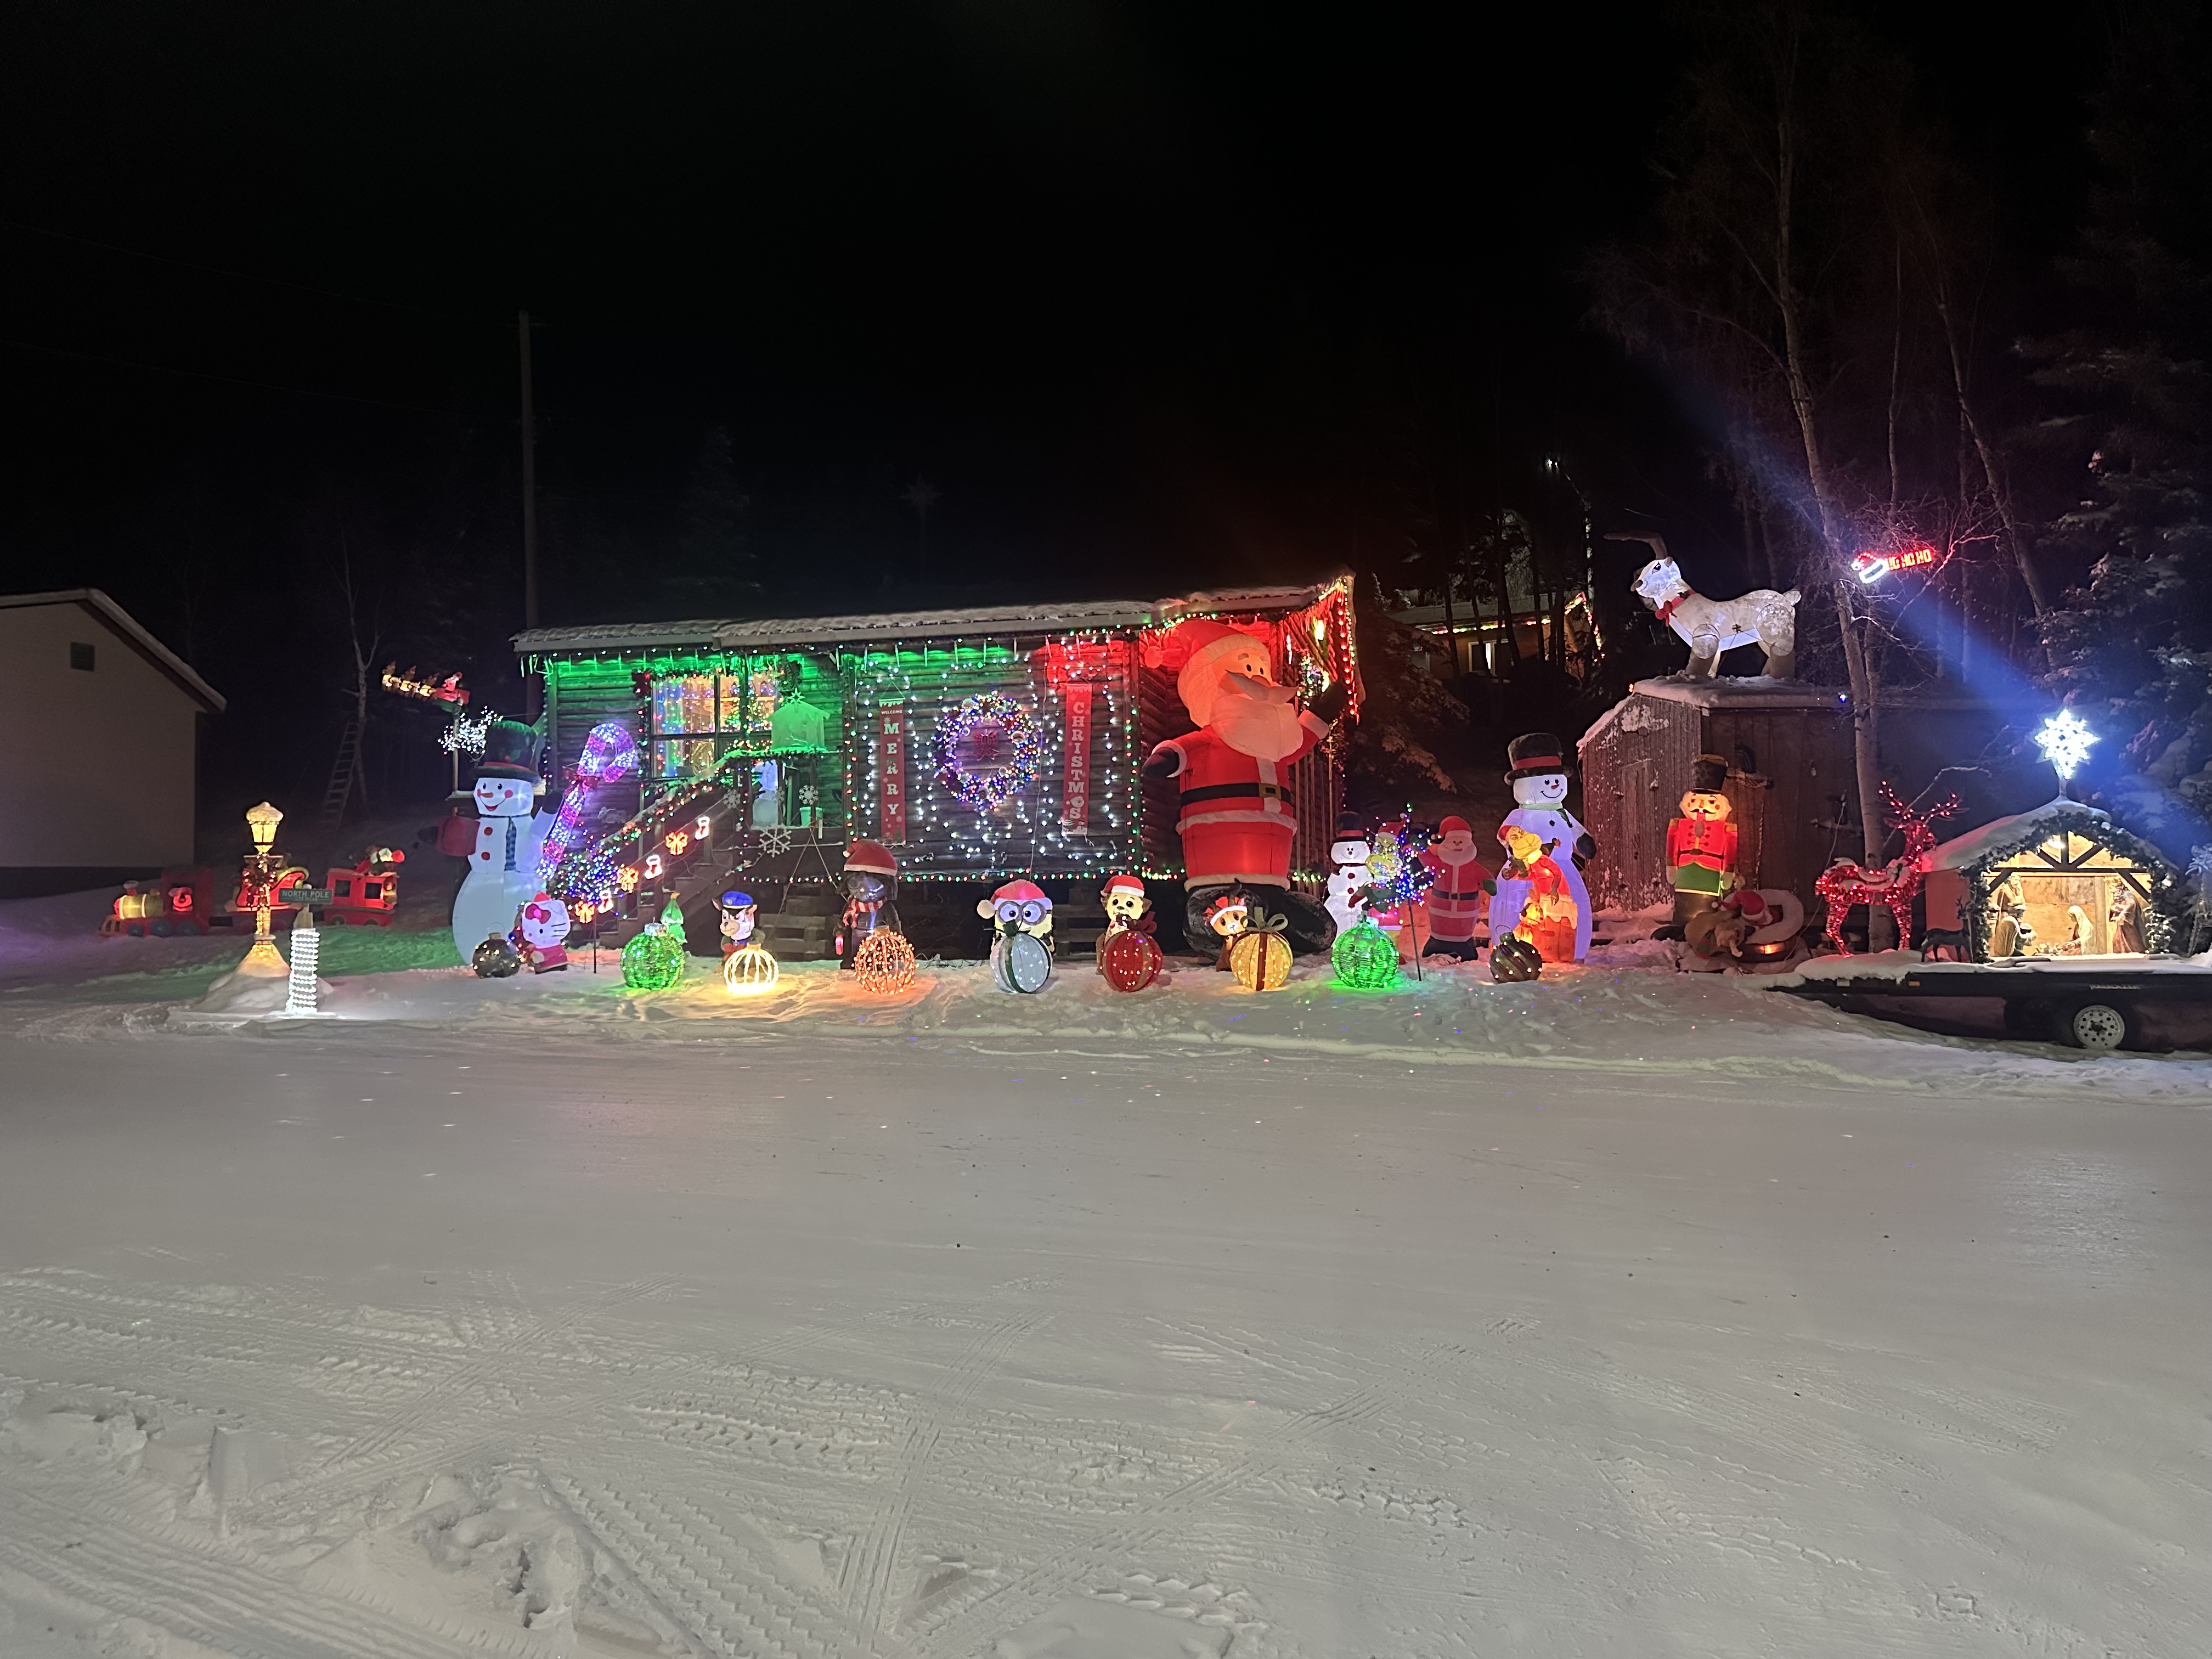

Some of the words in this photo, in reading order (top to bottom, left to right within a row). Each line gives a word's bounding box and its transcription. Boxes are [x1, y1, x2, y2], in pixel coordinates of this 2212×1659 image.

[1901, 553, 1915, 567] HO
[1916, 550, 1932, 564] HO
[883, 722, 900, 815] MERRY
[1068, 702, 1085, 819] CHRISTMS
